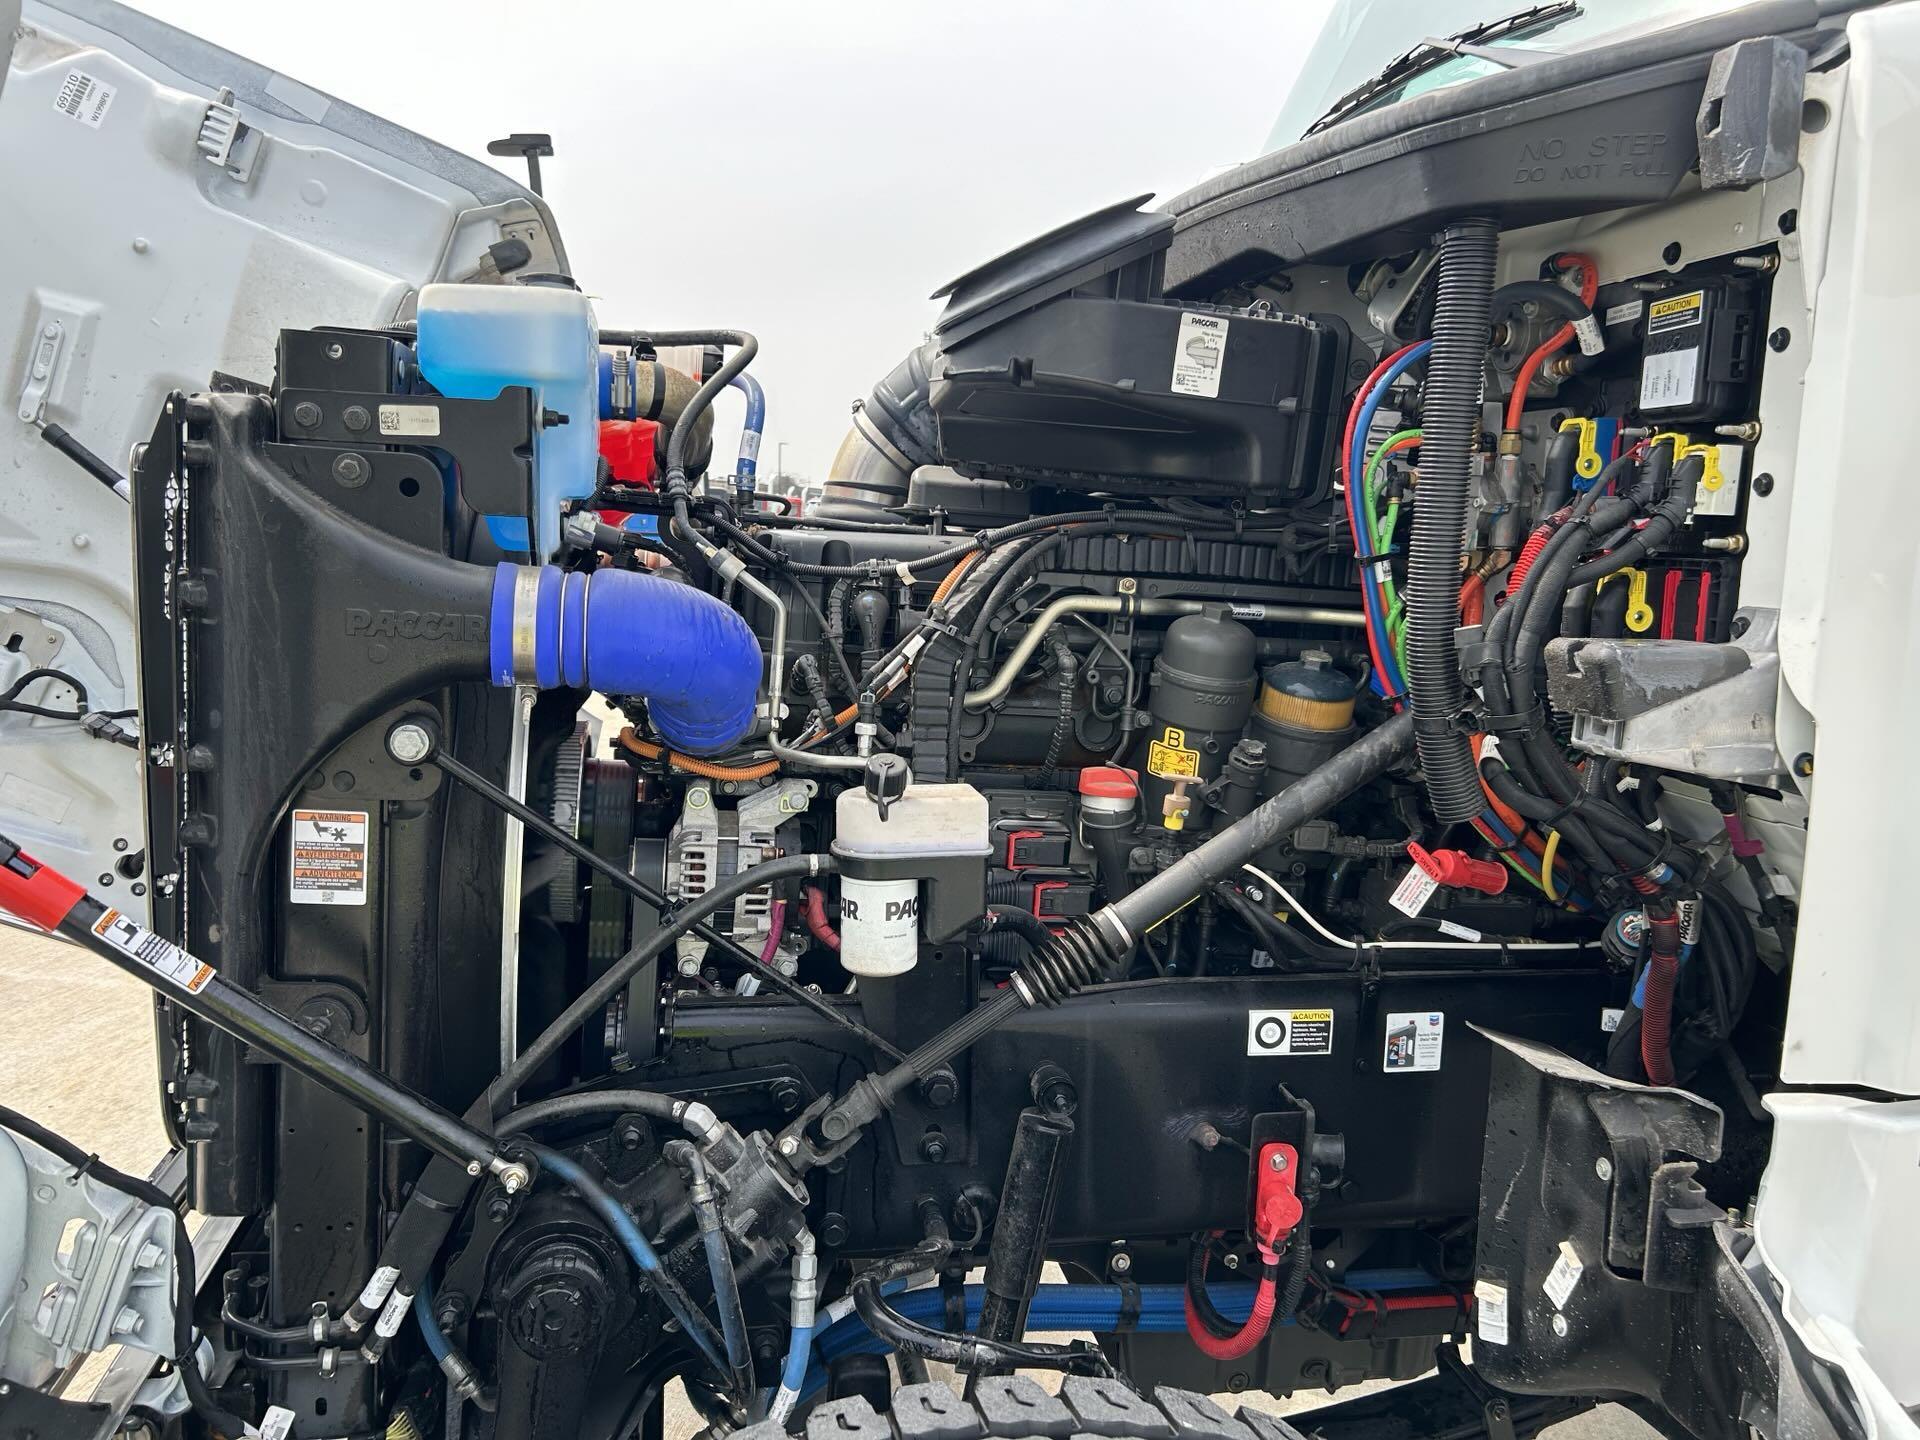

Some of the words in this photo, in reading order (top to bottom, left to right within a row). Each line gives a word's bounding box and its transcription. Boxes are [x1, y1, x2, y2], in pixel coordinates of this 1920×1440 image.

[57, 74, 79, 109] 691210
[1520, 136, 1565, 162] NO
[1588, 133, 1669, 157] STEP
[1513, 167, 1547, 184] DO
[1560, 163, 1608, 181] NOT
[1619, 161, 1673, 177] PULL
[1661, 299, 1692, 313] CAUTION
[1192, 318, 1218, 328] PACCAR
[344, 607, 489, 643] PACCAR
[1168, 729, 1181, 748] B
[318, 813, 352, 822] WARNING
[305, 851, 361, 860] AVERTISSEMENT
[309, 869, 357, 878] ADVERTENCIA
[1680, 903, 1694, 940] PACCAR
[1298, 1012, 1331, 1020] CAUTION
